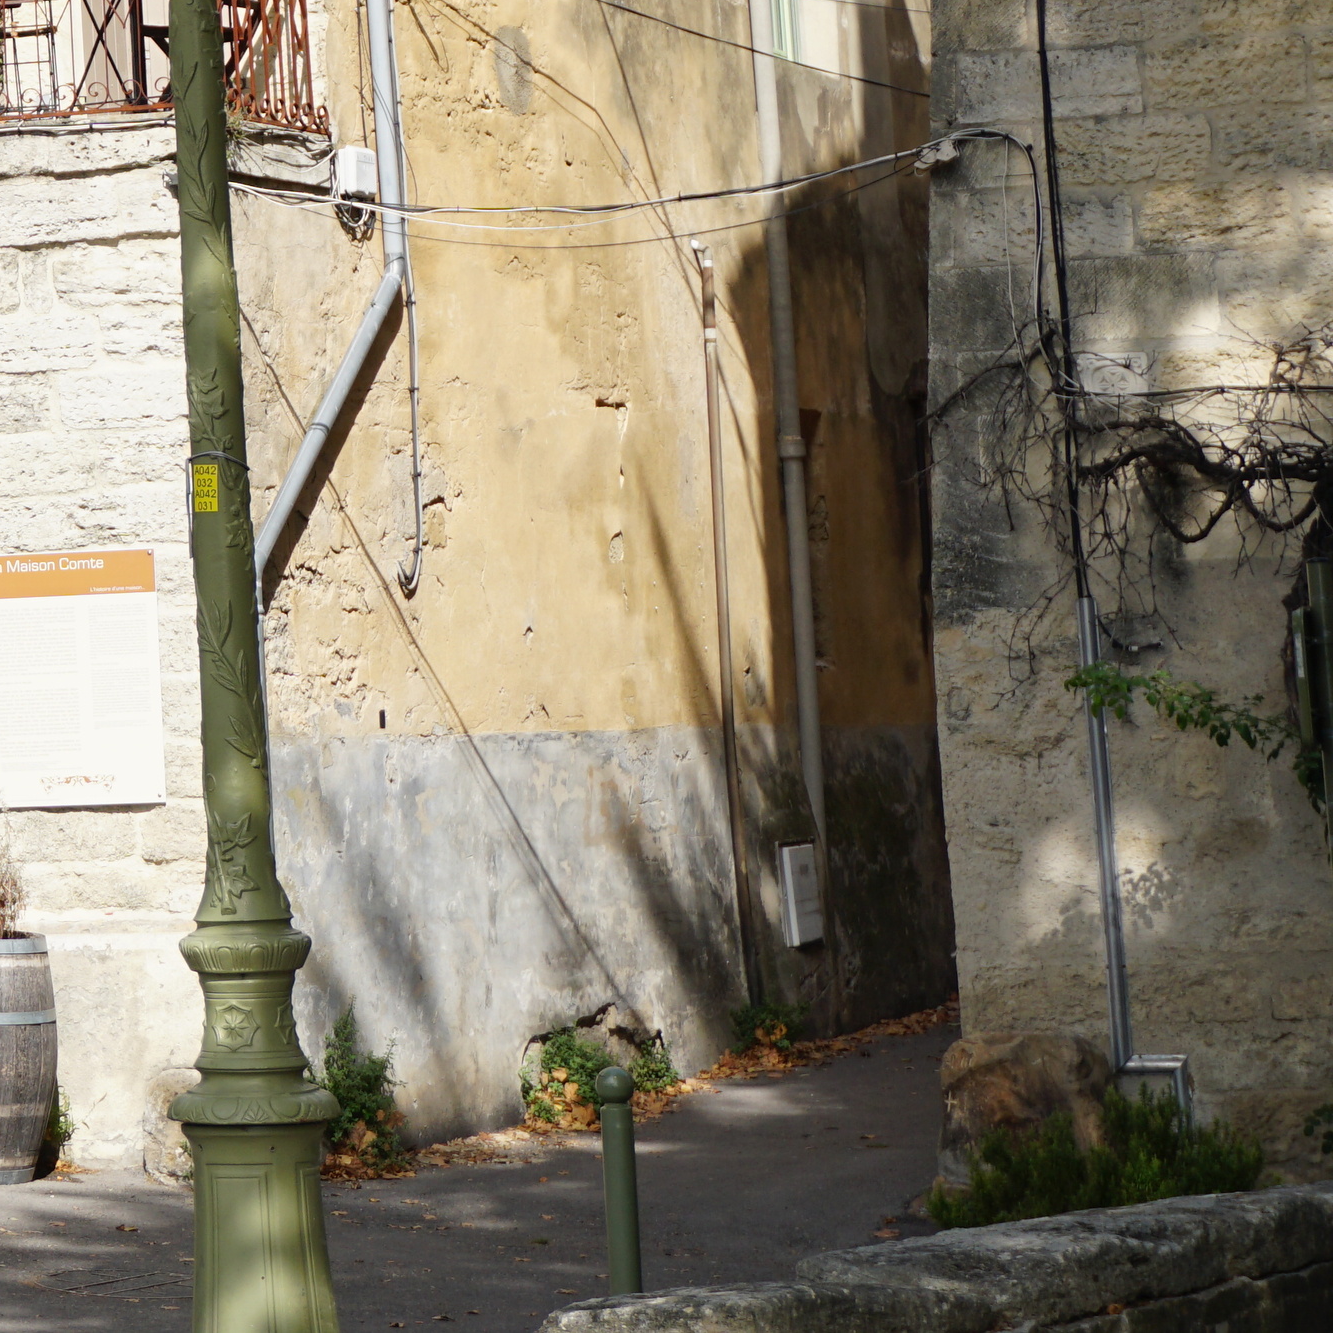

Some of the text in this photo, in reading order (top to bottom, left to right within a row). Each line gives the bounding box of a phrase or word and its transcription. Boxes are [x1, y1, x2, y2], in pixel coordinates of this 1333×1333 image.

[194, 466, 217, 475] A042
[196, 478, 213, 487] 032
[195, 489, 217, 498] A042
[198, 501, 213, 510] 031
[6, 559, 56, 573] Maison
[59, 557, 104, 571] Comte
